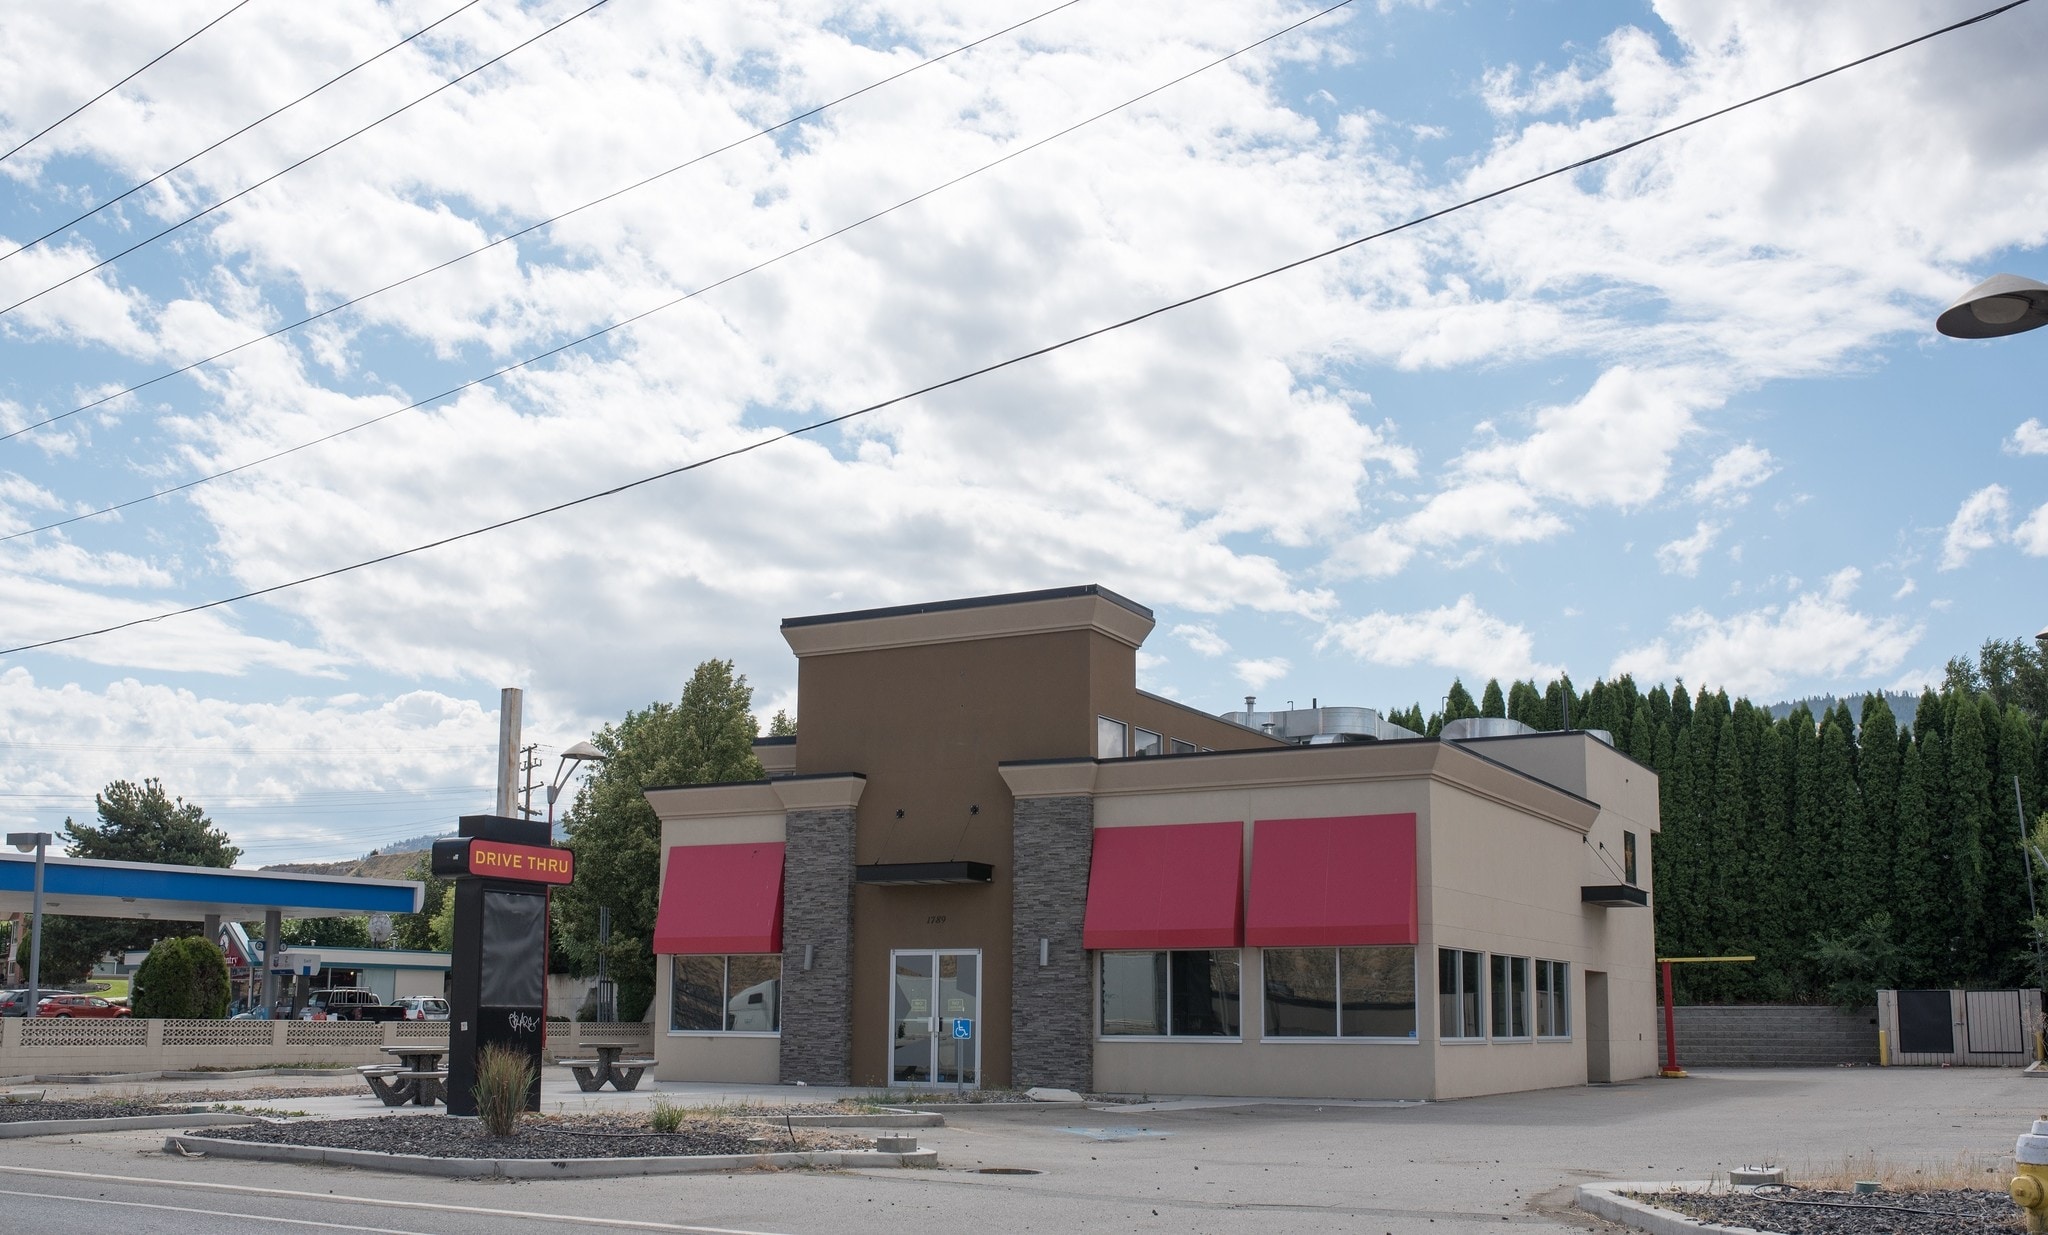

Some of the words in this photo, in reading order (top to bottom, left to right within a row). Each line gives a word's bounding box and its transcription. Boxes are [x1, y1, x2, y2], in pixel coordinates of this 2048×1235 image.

[475, 850, 522, 868] DRIVE
[528, 856, 568, 873] THRU
[927, 916, 946, 924] 1789
